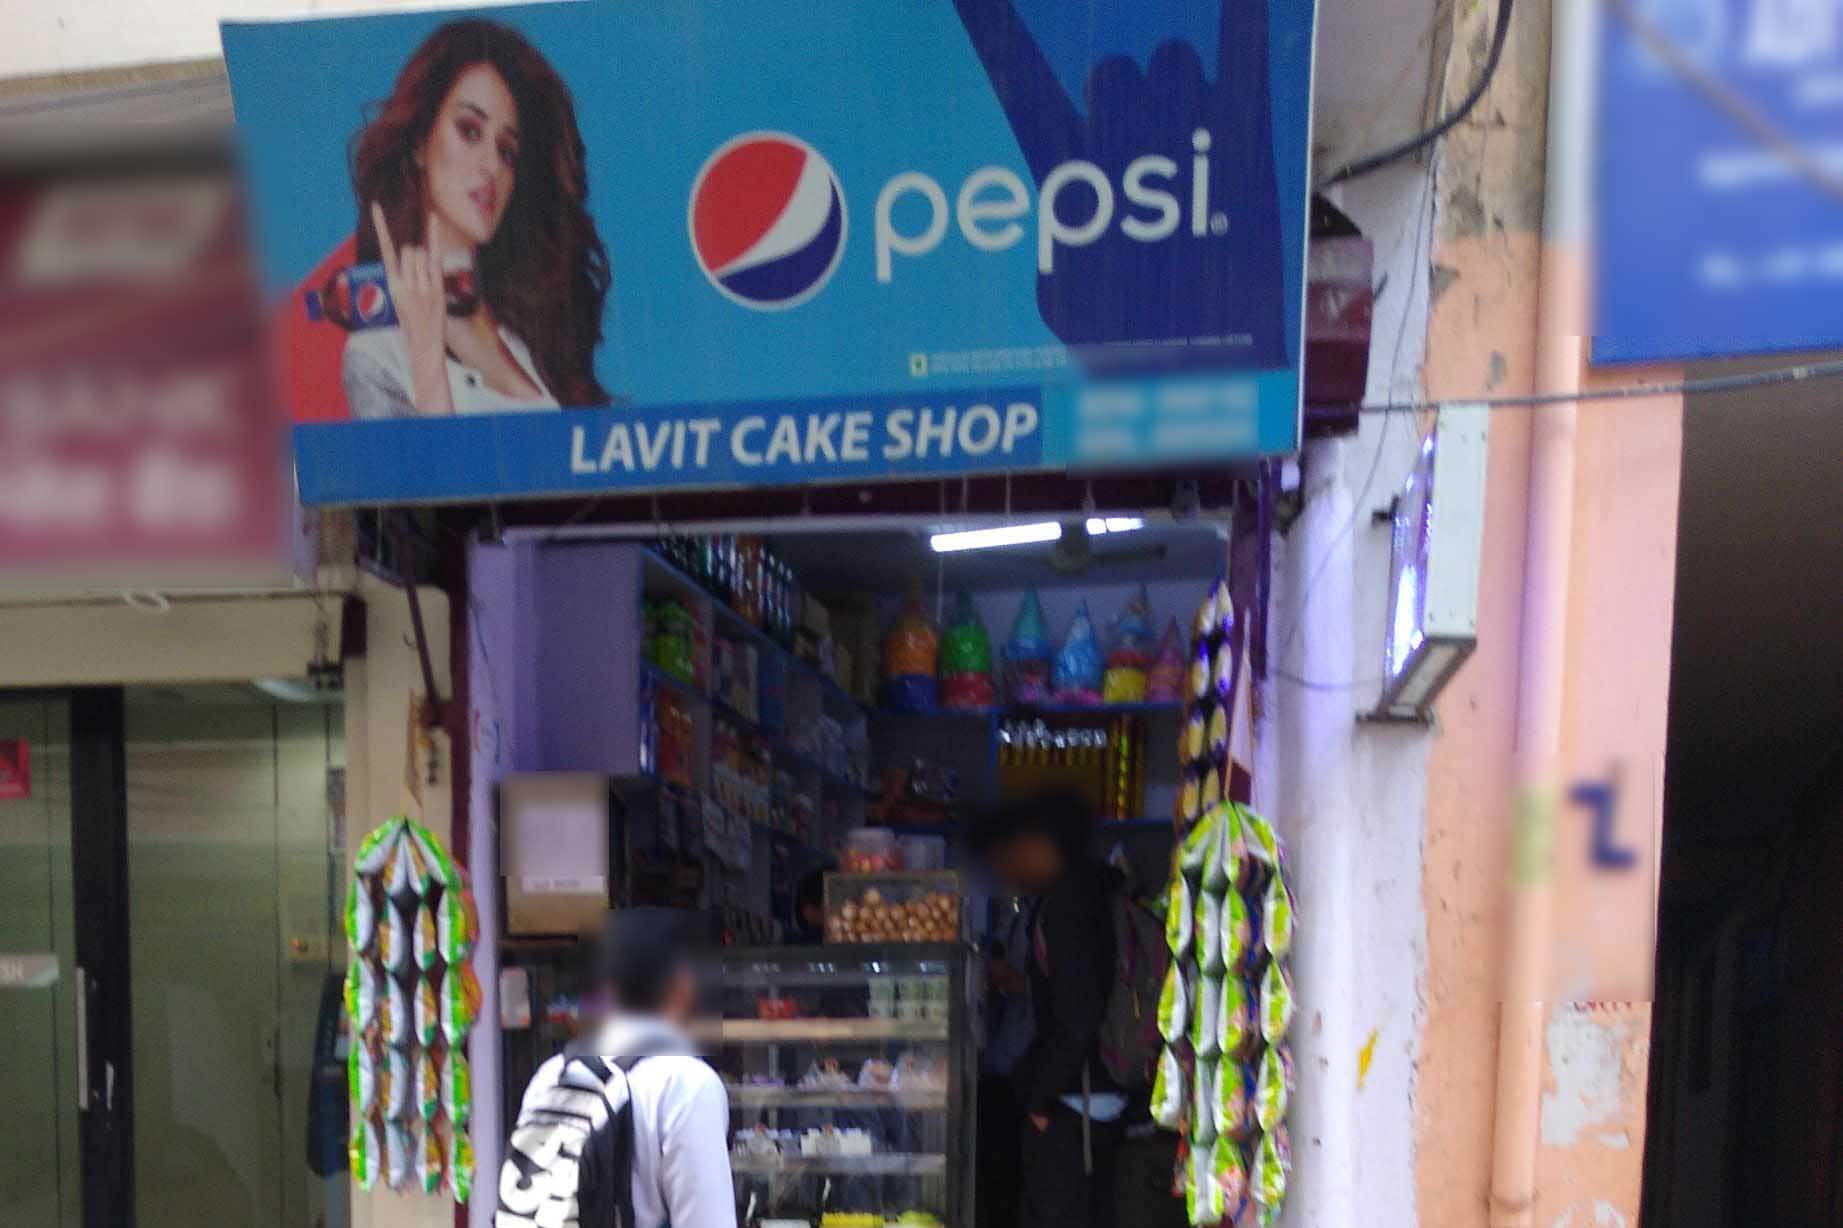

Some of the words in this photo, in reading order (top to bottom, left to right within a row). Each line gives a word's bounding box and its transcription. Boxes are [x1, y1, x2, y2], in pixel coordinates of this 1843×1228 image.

[875, 127, 1212, 284] pepsi
[570, 416, 721, 475] LAVIT
[729, 410, 874, 466] CAKE
[882, 402, 1039, 461] SHOP
